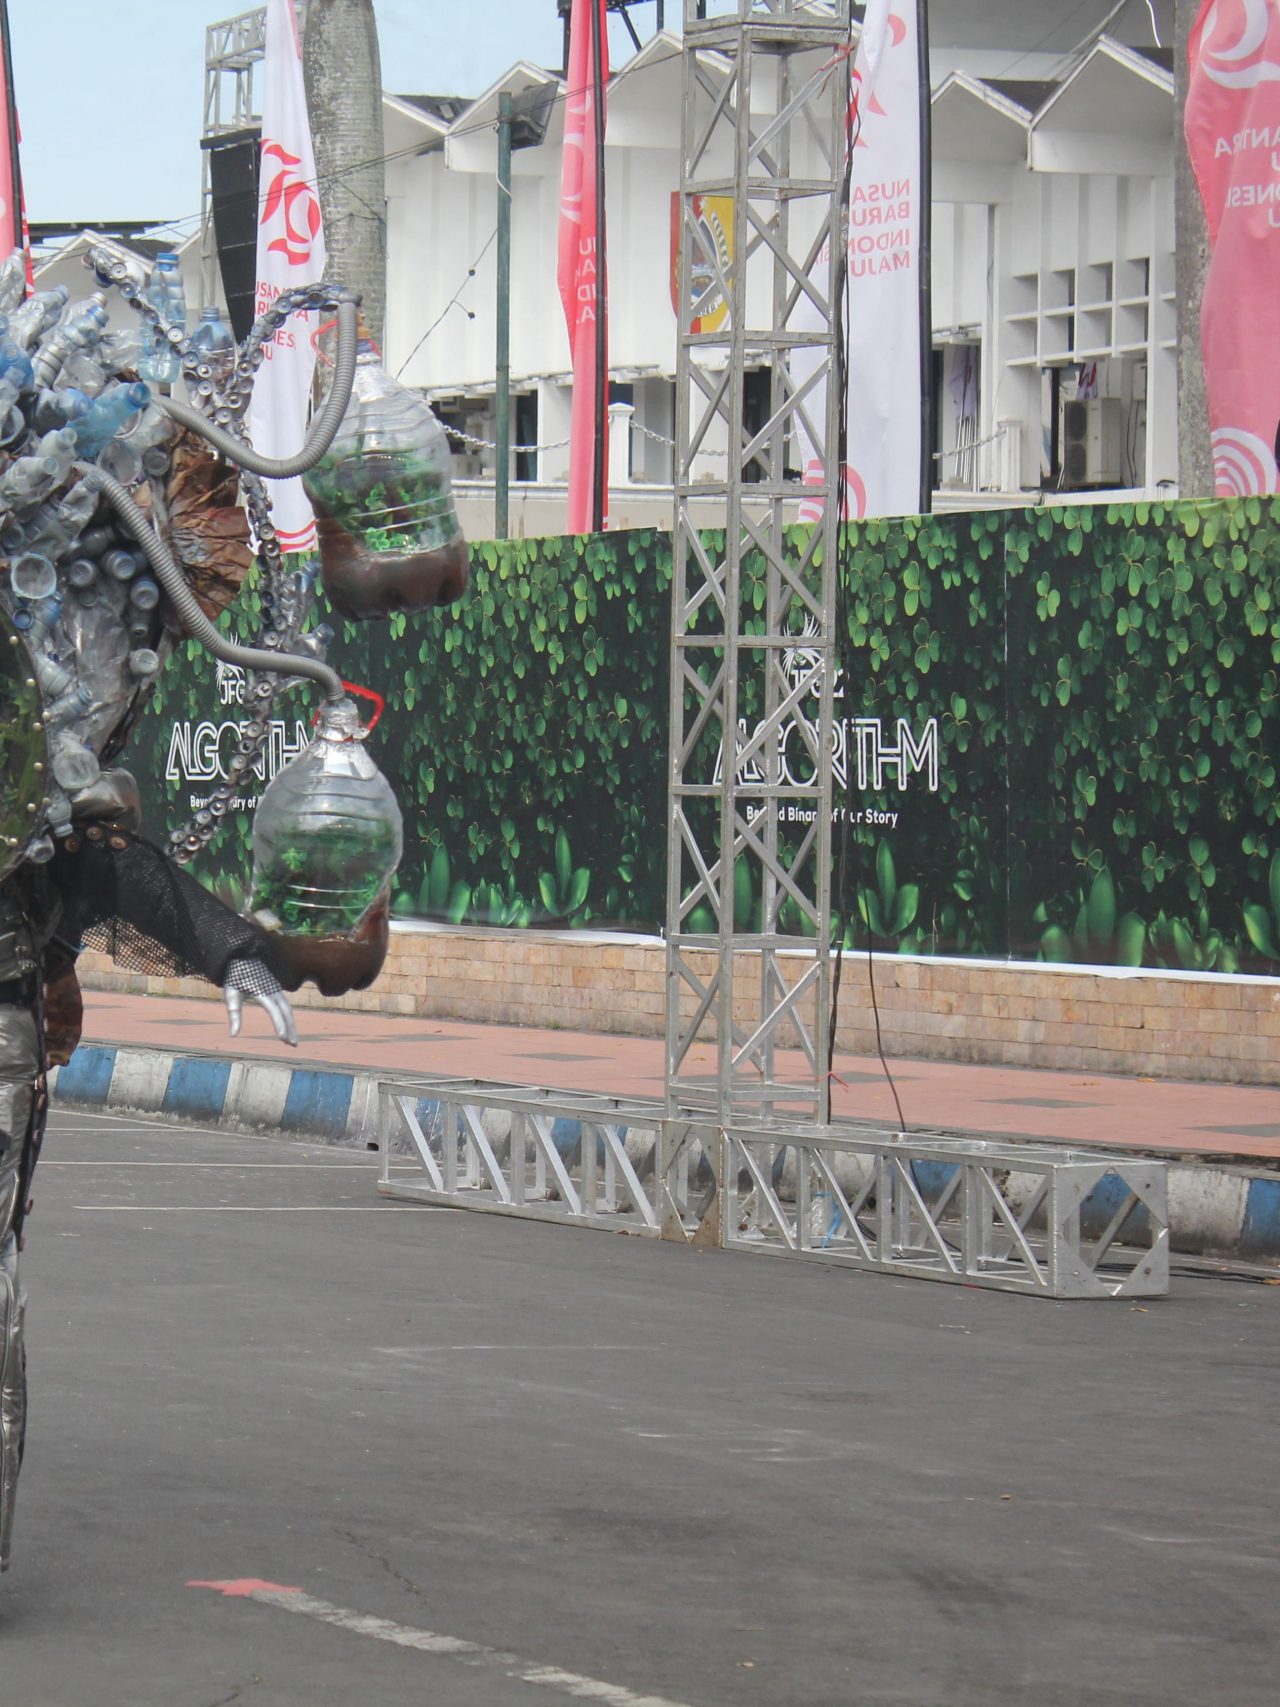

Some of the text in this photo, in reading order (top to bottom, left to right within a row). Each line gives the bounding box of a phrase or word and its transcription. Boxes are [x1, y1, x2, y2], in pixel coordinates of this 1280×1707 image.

[248, 796, 256, 808] of
[788, 806, 817, 822] Binar
[865, 808, 899, 829] Story
